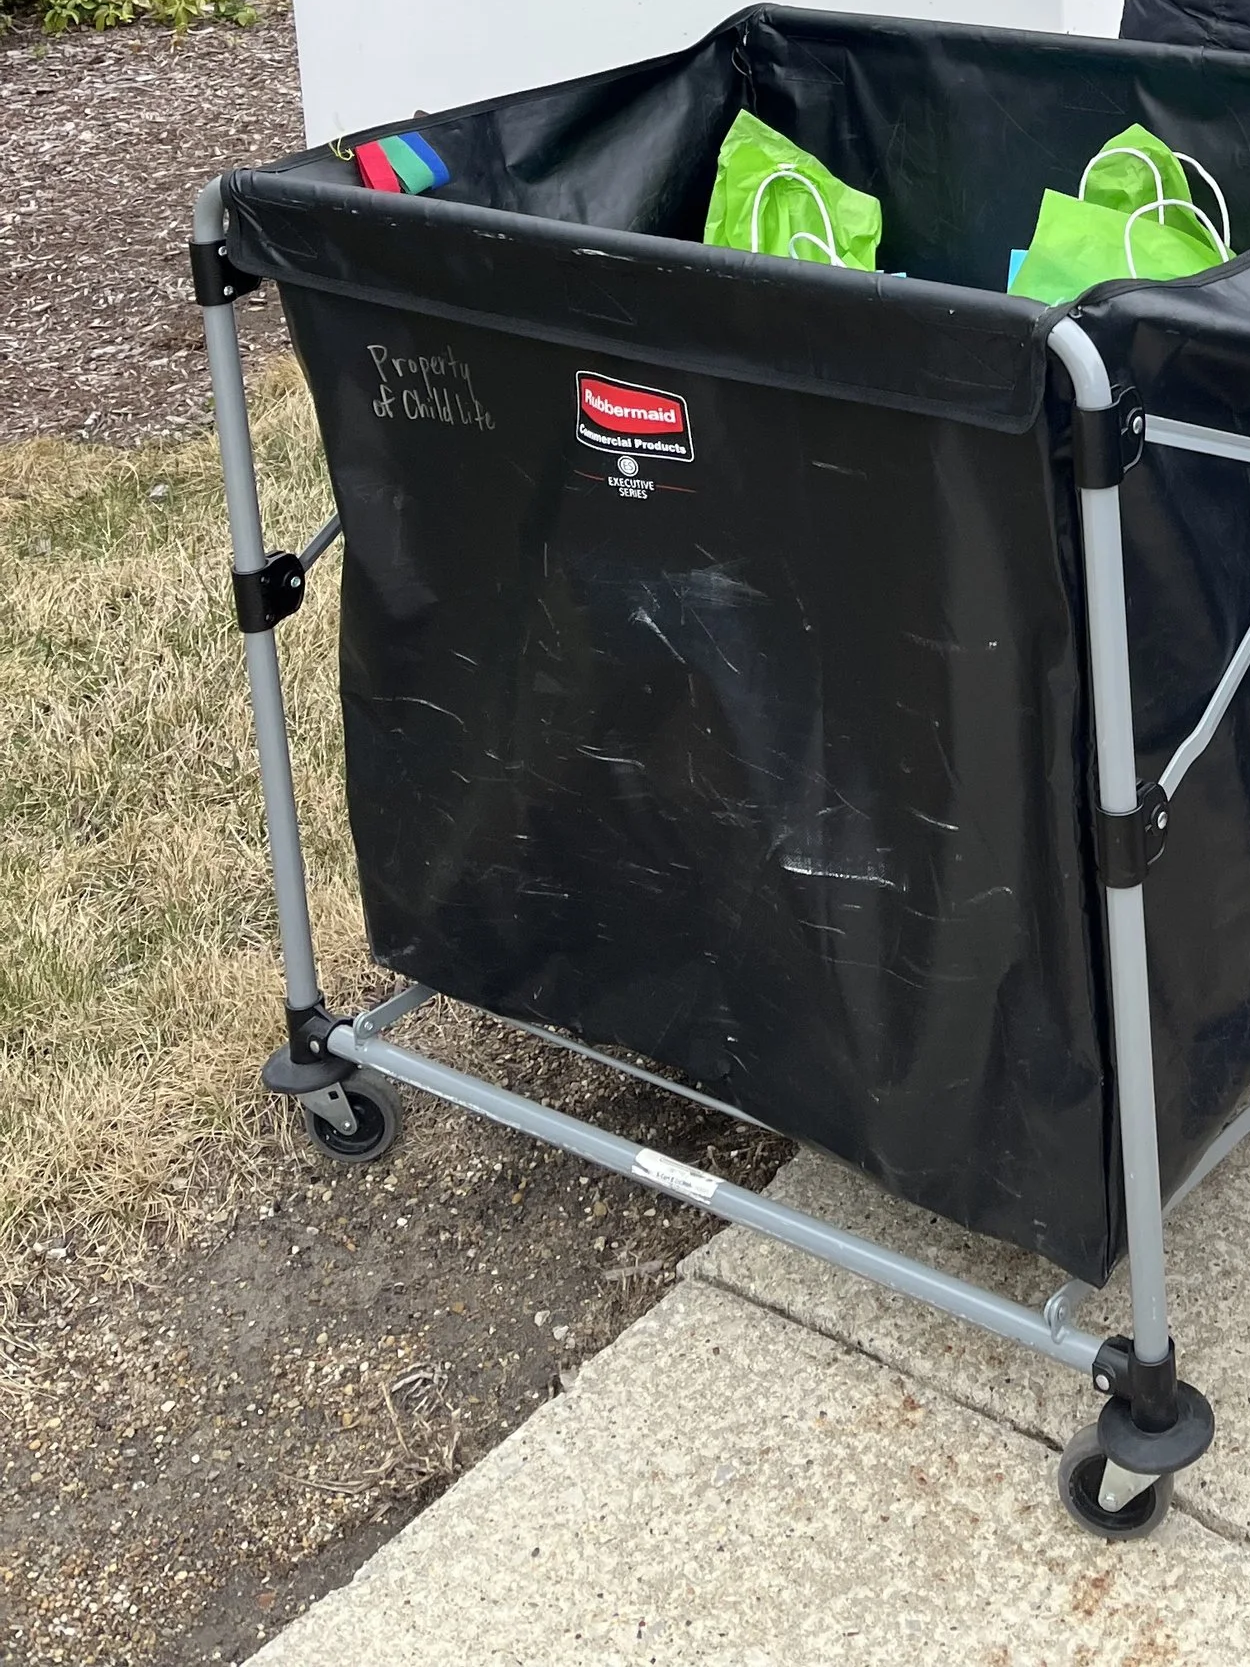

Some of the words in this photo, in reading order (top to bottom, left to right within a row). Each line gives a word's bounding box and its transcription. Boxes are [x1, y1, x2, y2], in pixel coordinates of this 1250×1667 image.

[367, 345, 476, 401] Property
[373, 384, 395, 418] of
[403, 387, 454, 425] Child
[585, 388, 677, 424] Rubbermaid
[579, 423, 632, 448] Commercial
[634, 438, 687, 455] Products
[608, 476, 655, 491] EXECUTIVE
[619, 488, 648, 500] SERIES
